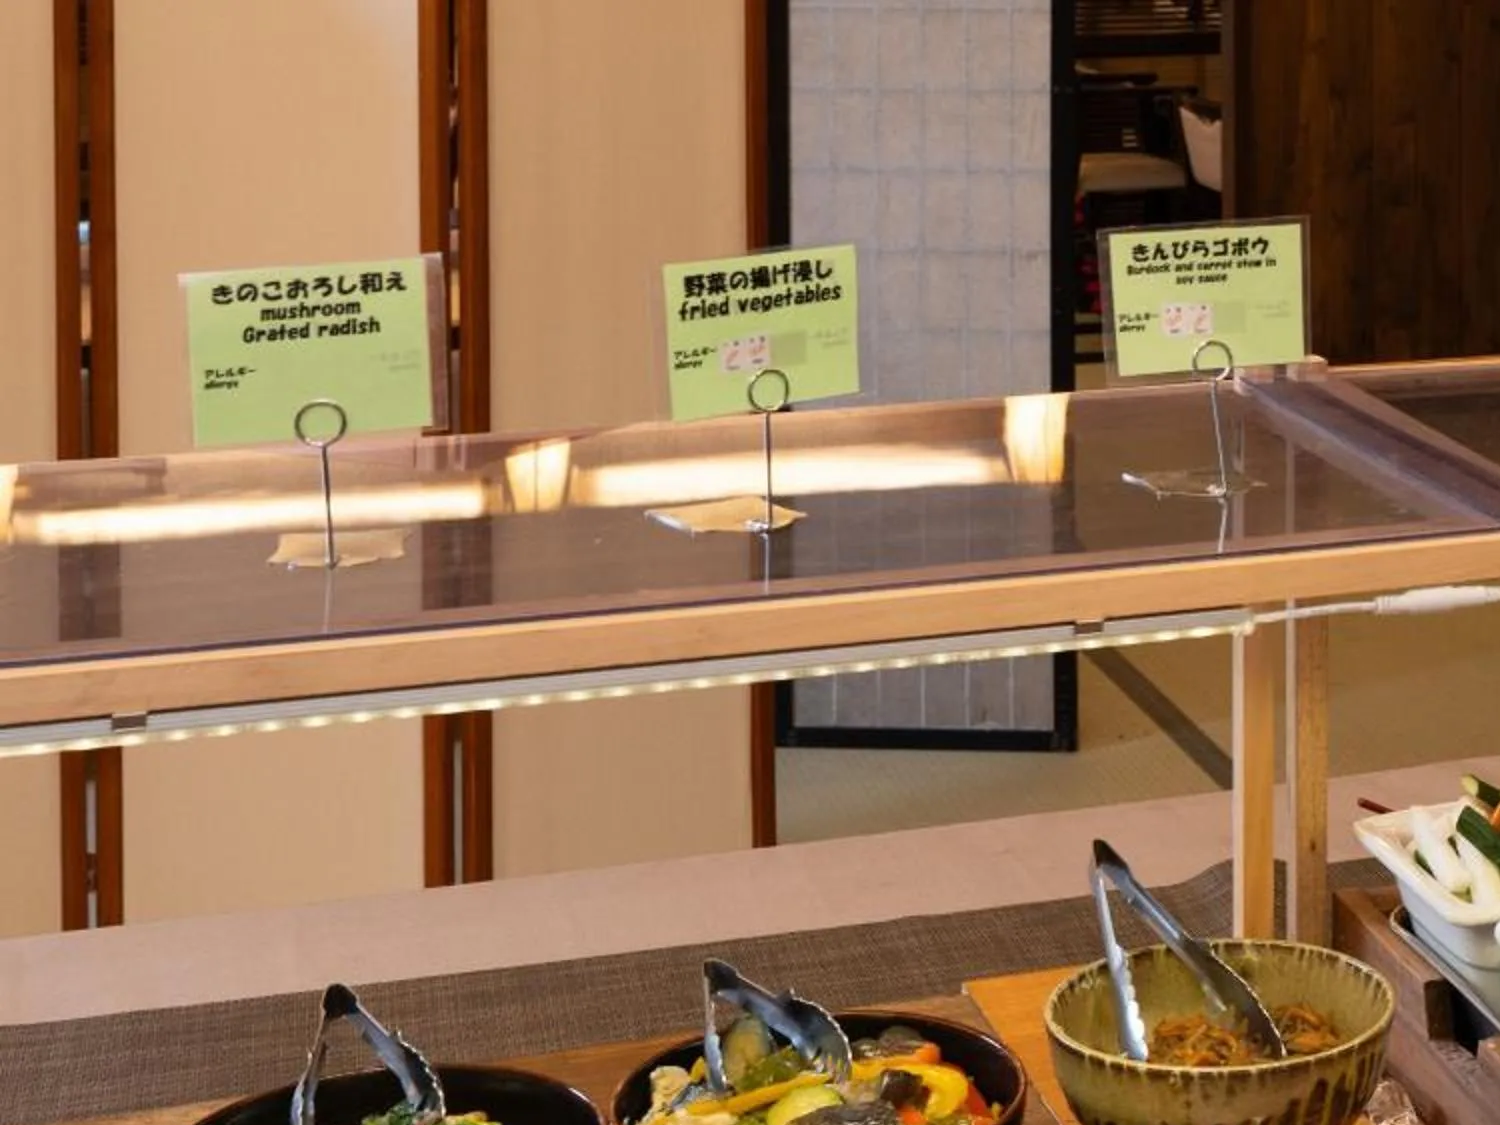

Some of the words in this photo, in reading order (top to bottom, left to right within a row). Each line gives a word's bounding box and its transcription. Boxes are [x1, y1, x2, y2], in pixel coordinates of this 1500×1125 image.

[1131, 236, 1270, 263] きんぴらゴボウ
[683, 260, 833, 298] 野菜の揚げ浸し
[1126, 263, 1171, 276] Burdock
[1174, 261, 1194, 272] and
[1197, 259, 1234, 271] carrot
[1265, 256, 1277, 267] in
[211, 271, 407, 305] きのこおろし和え
[1175, 276, 1195, 286] soy
[1198, 274, 1228, 285] sauce
[260, 301, 362, 322] mushroom
[678, 296, 730, 322] fried
[738, 284, 842, 314] vegetables
[242, 323, 310, 344] Grated
[317, 316, 381, 337] radish
[204, 366, 257, 380] アレルギー
